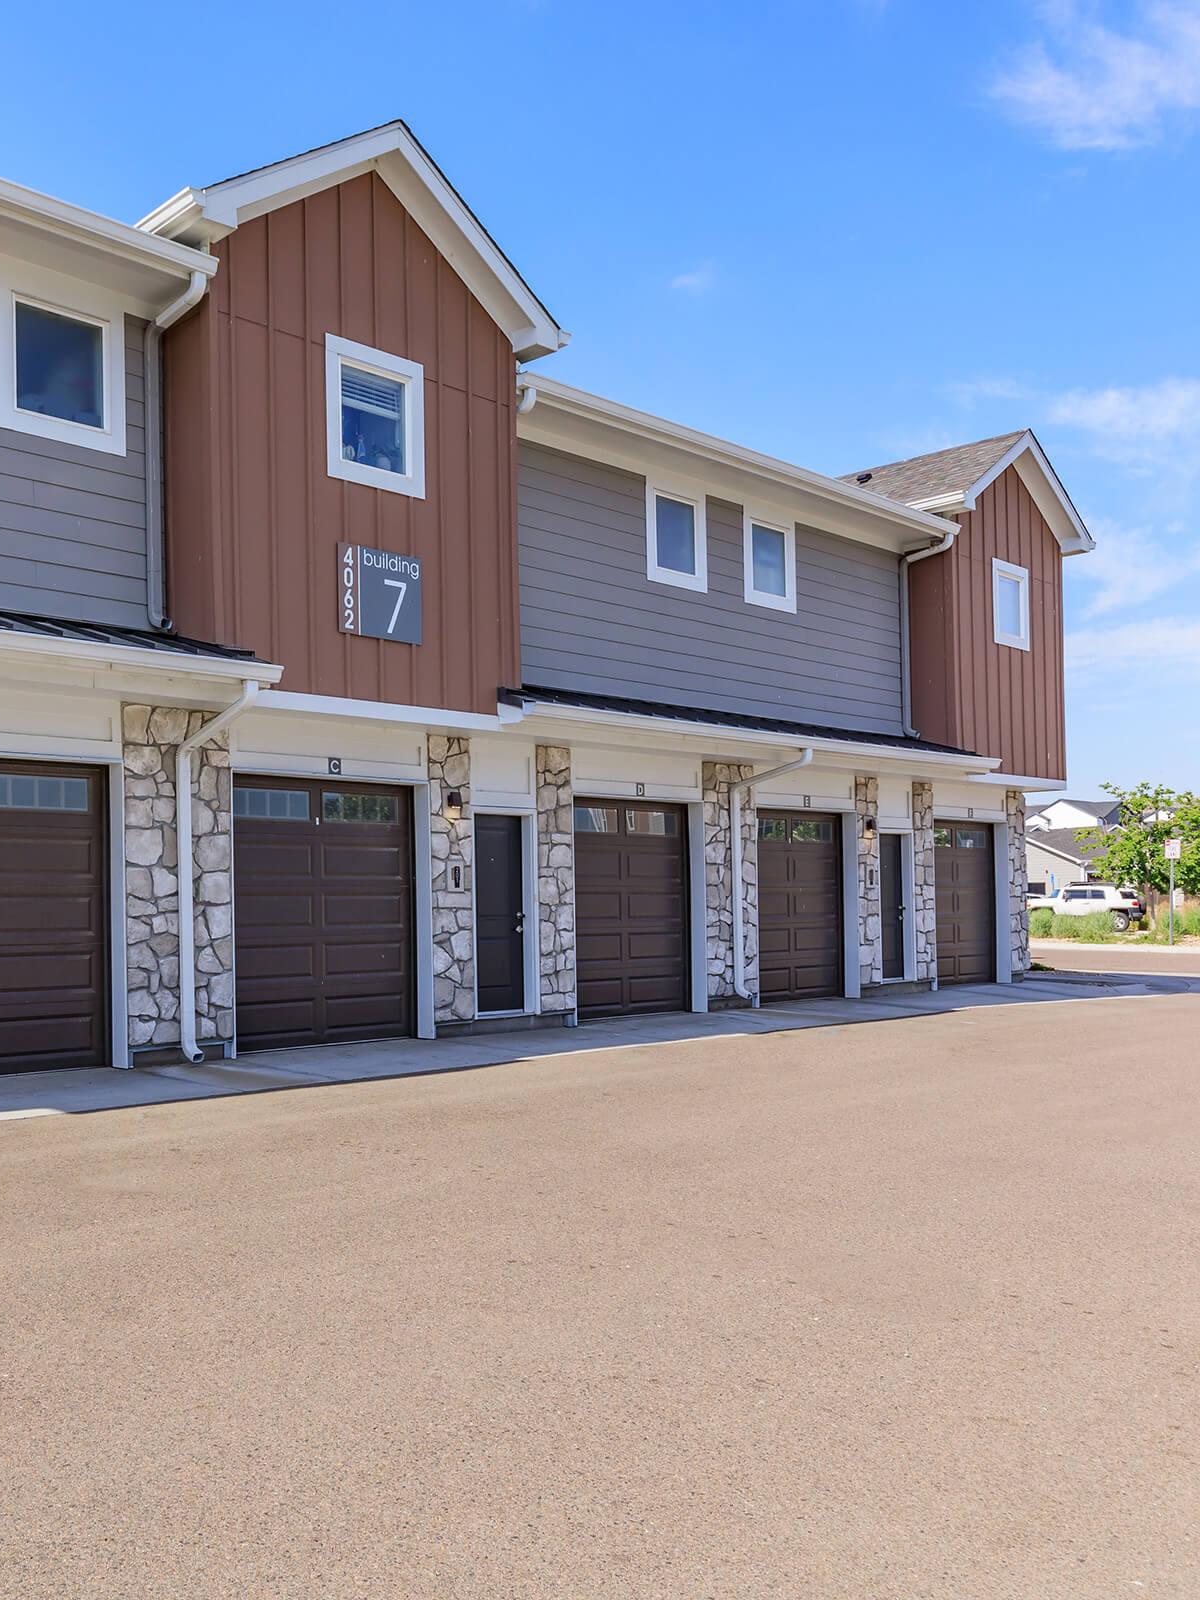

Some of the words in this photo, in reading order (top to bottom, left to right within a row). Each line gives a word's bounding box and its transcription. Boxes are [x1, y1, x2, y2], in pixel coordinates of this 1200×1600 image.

[363, 548, 420, 580] building
[343, 546, 354, 630] 4062
[383, 578, 407, 634] 7
[330, 760, 340, 773] C
